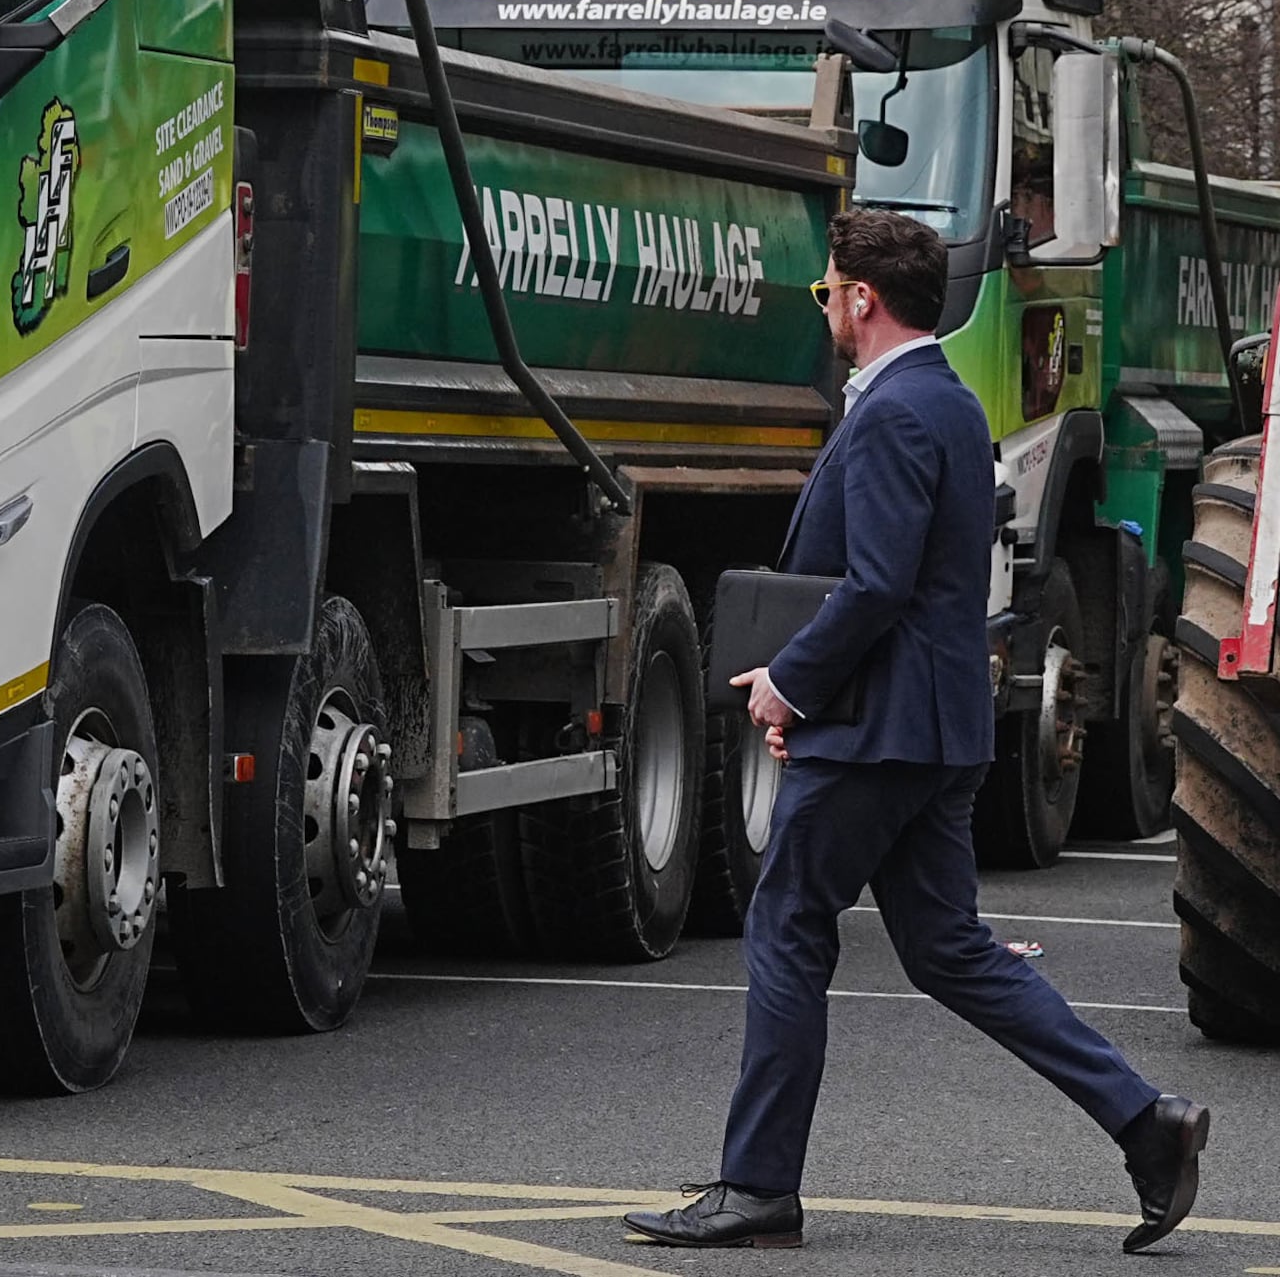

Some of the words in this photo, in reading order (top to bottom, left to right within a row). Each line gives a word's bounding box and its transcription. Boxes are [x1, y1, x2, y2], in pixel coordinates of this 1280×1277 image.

[155, 117, 176, 156] SITE
[177, 81, 224, 140] CLEARANCE
[158, 156, 184, 198] SAND
[193, 124, 224, 171] GRAVEL
[632, 210, 764, 316] HAULAGE
